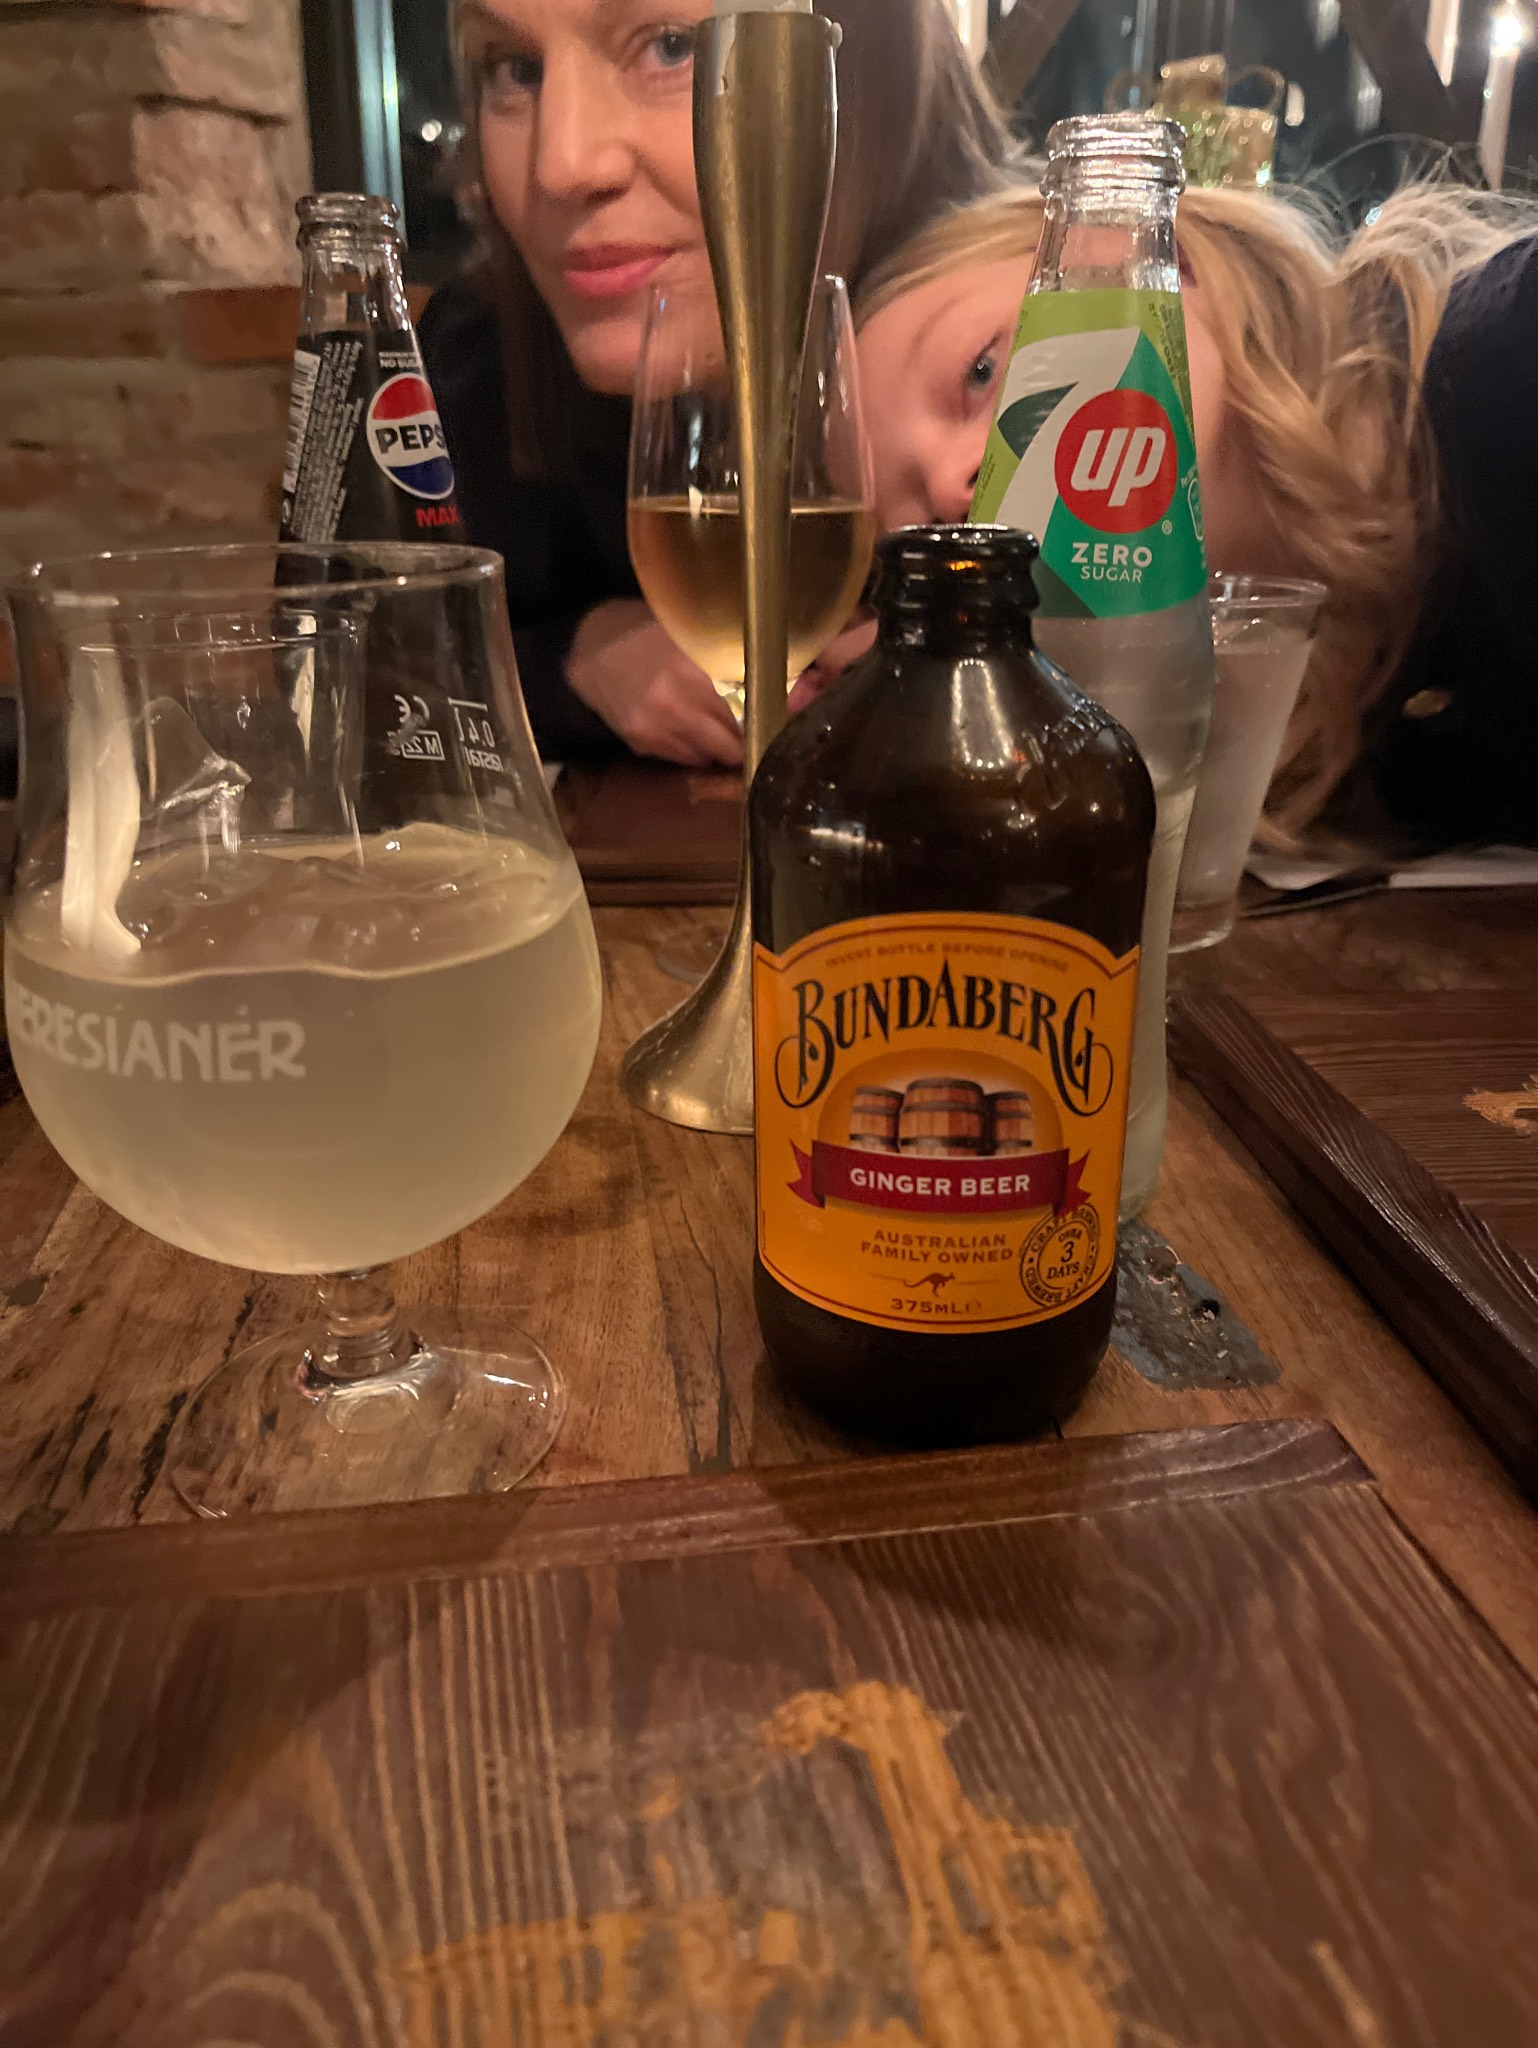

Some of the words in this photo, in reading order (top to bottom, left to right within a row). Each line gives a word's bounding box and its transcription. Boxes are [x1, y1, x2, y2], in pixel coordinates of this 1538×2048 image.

[1070, 542, 1153, 568] ZERO
[1079, 565, 1143, 583] SUGAR
[774, 959, 1114, 1117] BUNDABERG
[850, 1167, 952, 1197] GINGER
[960, 1174, 1031, 1195] BEER
[873, 1228, 1007, 1248] AUSTRALIAN
[860, 1241, 932, 1262] FAMILY
[937, 1248, 1013, 1264] OWNED
[1060, 1240, 1075, 1264] 3
[1046, 1260, 1081, 1280] DAYS
[890, 1298, 963, 1314] 375ML
